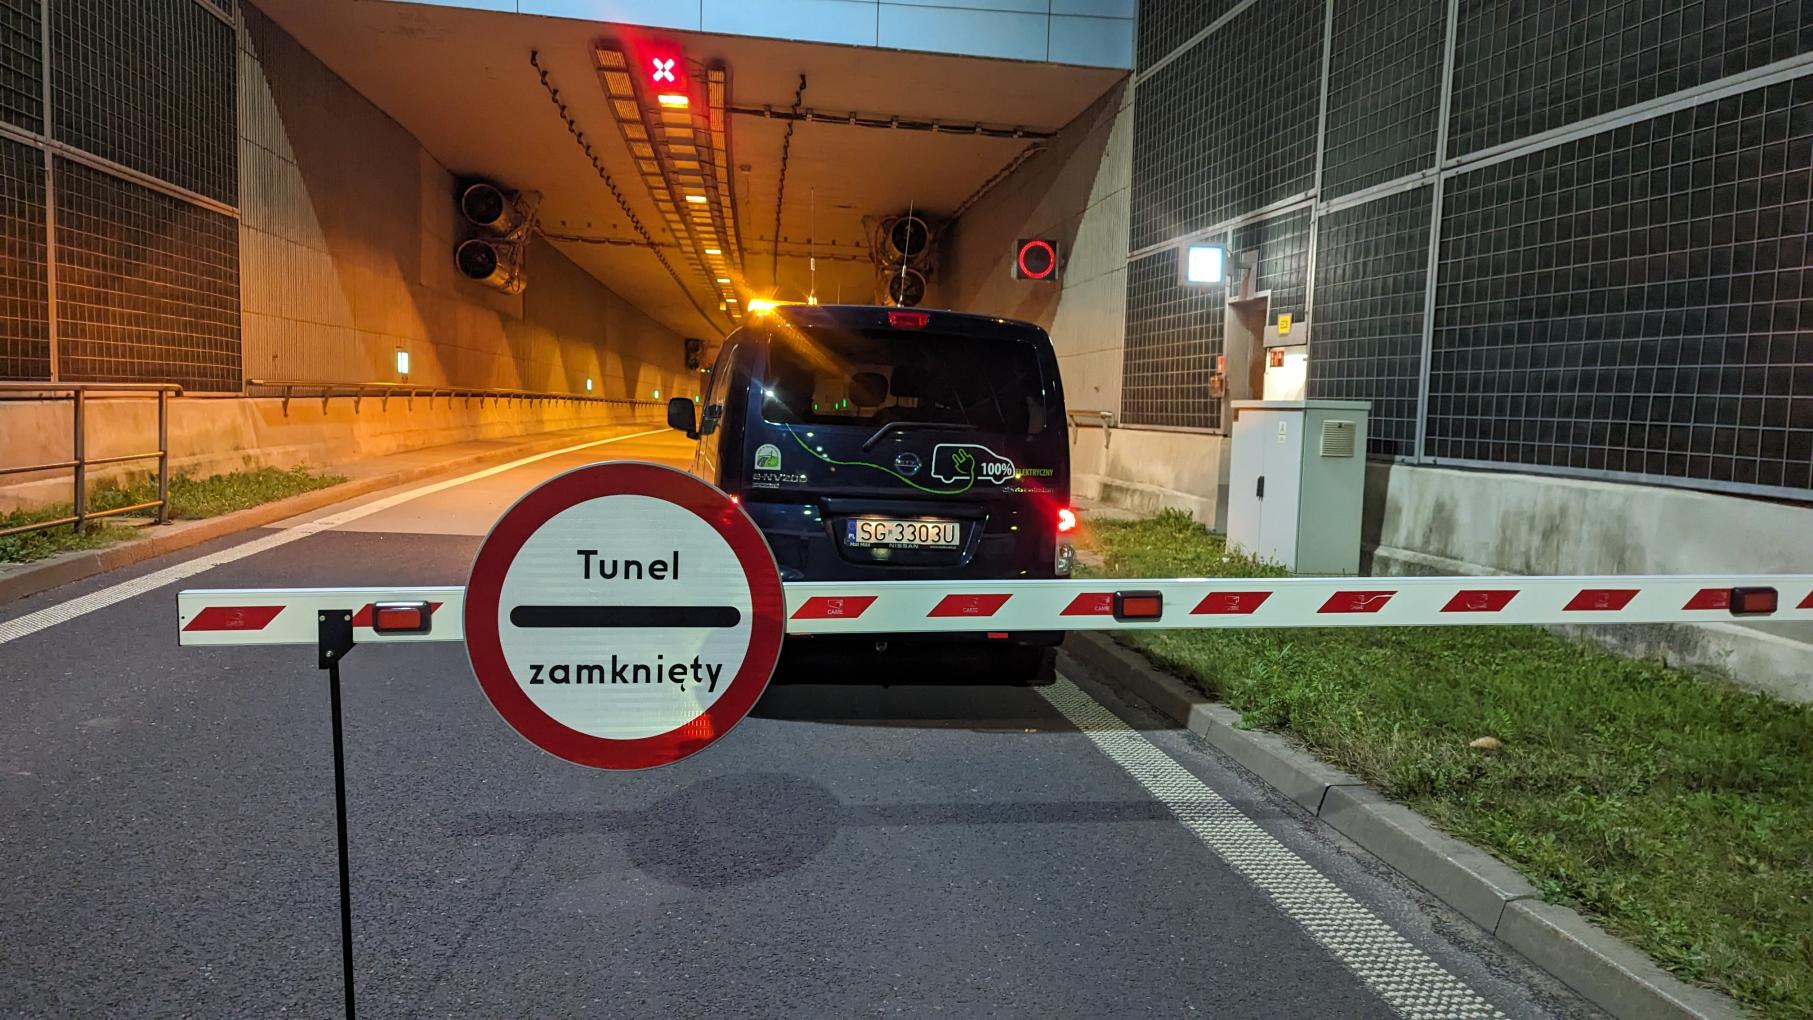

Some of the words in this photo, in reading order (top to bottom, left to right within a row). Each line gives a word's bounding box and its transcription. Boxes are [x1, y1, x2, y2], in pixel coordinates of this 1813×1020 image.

[981, 463, 1012, 475] 100%
[1015, 468, 1054, 477] ELEKTRYCZNY
[861, 523, 886, 541] SG
[895, 523, 955, 544] 3303U
[577, 549, 679, 580] Tunel
[529, 654, 723, 693] zamknięty
